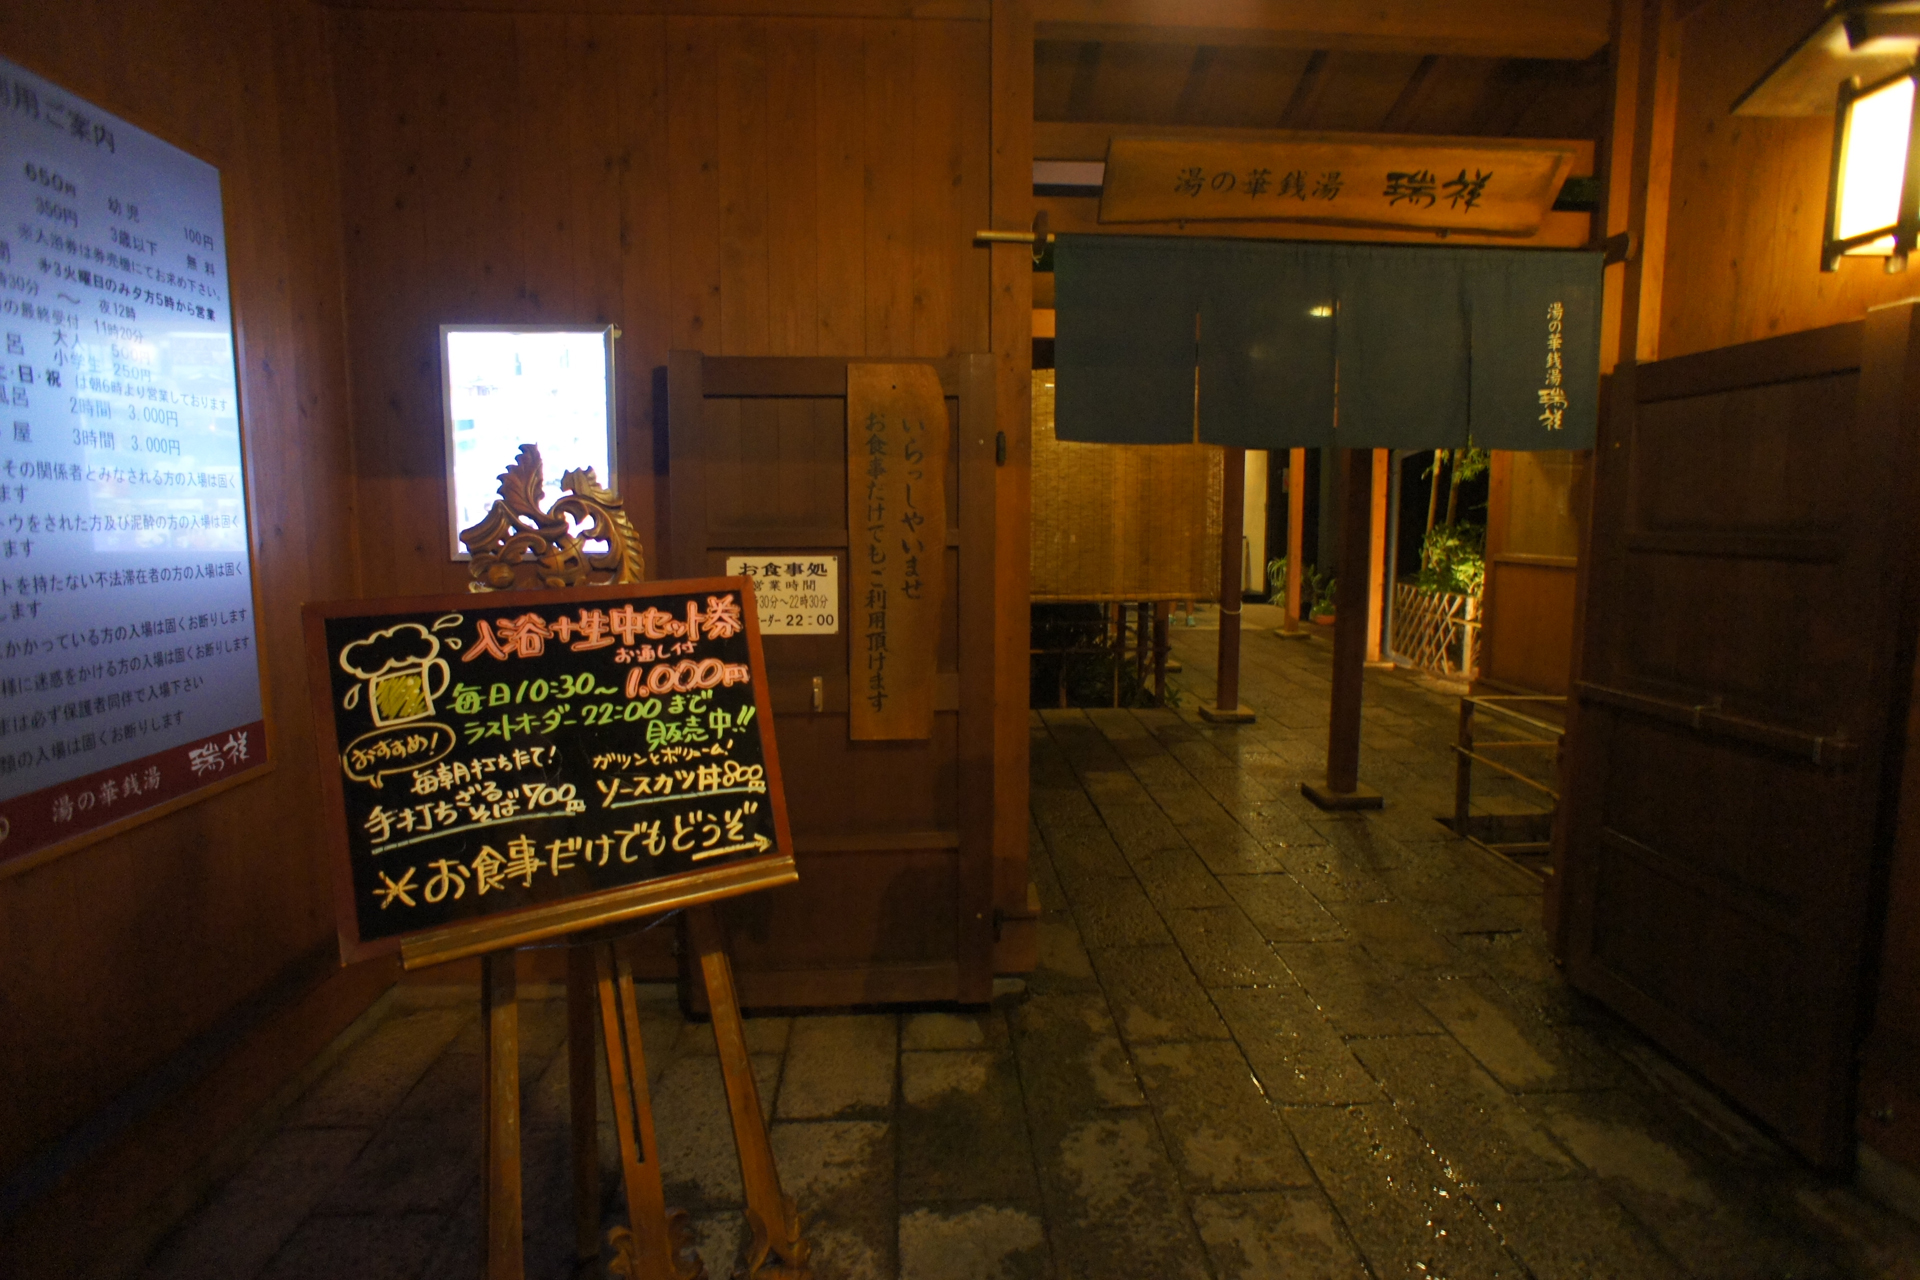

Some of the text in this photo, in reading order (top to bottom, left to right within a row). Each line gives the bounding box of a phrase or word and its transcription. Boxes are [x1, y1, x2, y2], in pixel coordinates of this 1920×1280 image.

[1174, 166, 1494, 214] 湯の華銭湯 瑞祥
[109, 226, 159, 257] 3歳以下
[183, 226, 215, 252] 100円
[99, 299, 137, 322] 夜12時
[94, 318, 144, 345] 11時20分
[112, 363, 153, 384] 250円
[69, 396, 112, 419] 2時間
[72, 427, 116, 451] 3時間
[3, 456, 237, 489] その関係者とみなされる方の入場は固く
[739, 561, 829, 578] お食事処
[614, 641, 698, 664] お通し付
[53, 731, 250, 826] 湯の華銭湯 瑞祥
